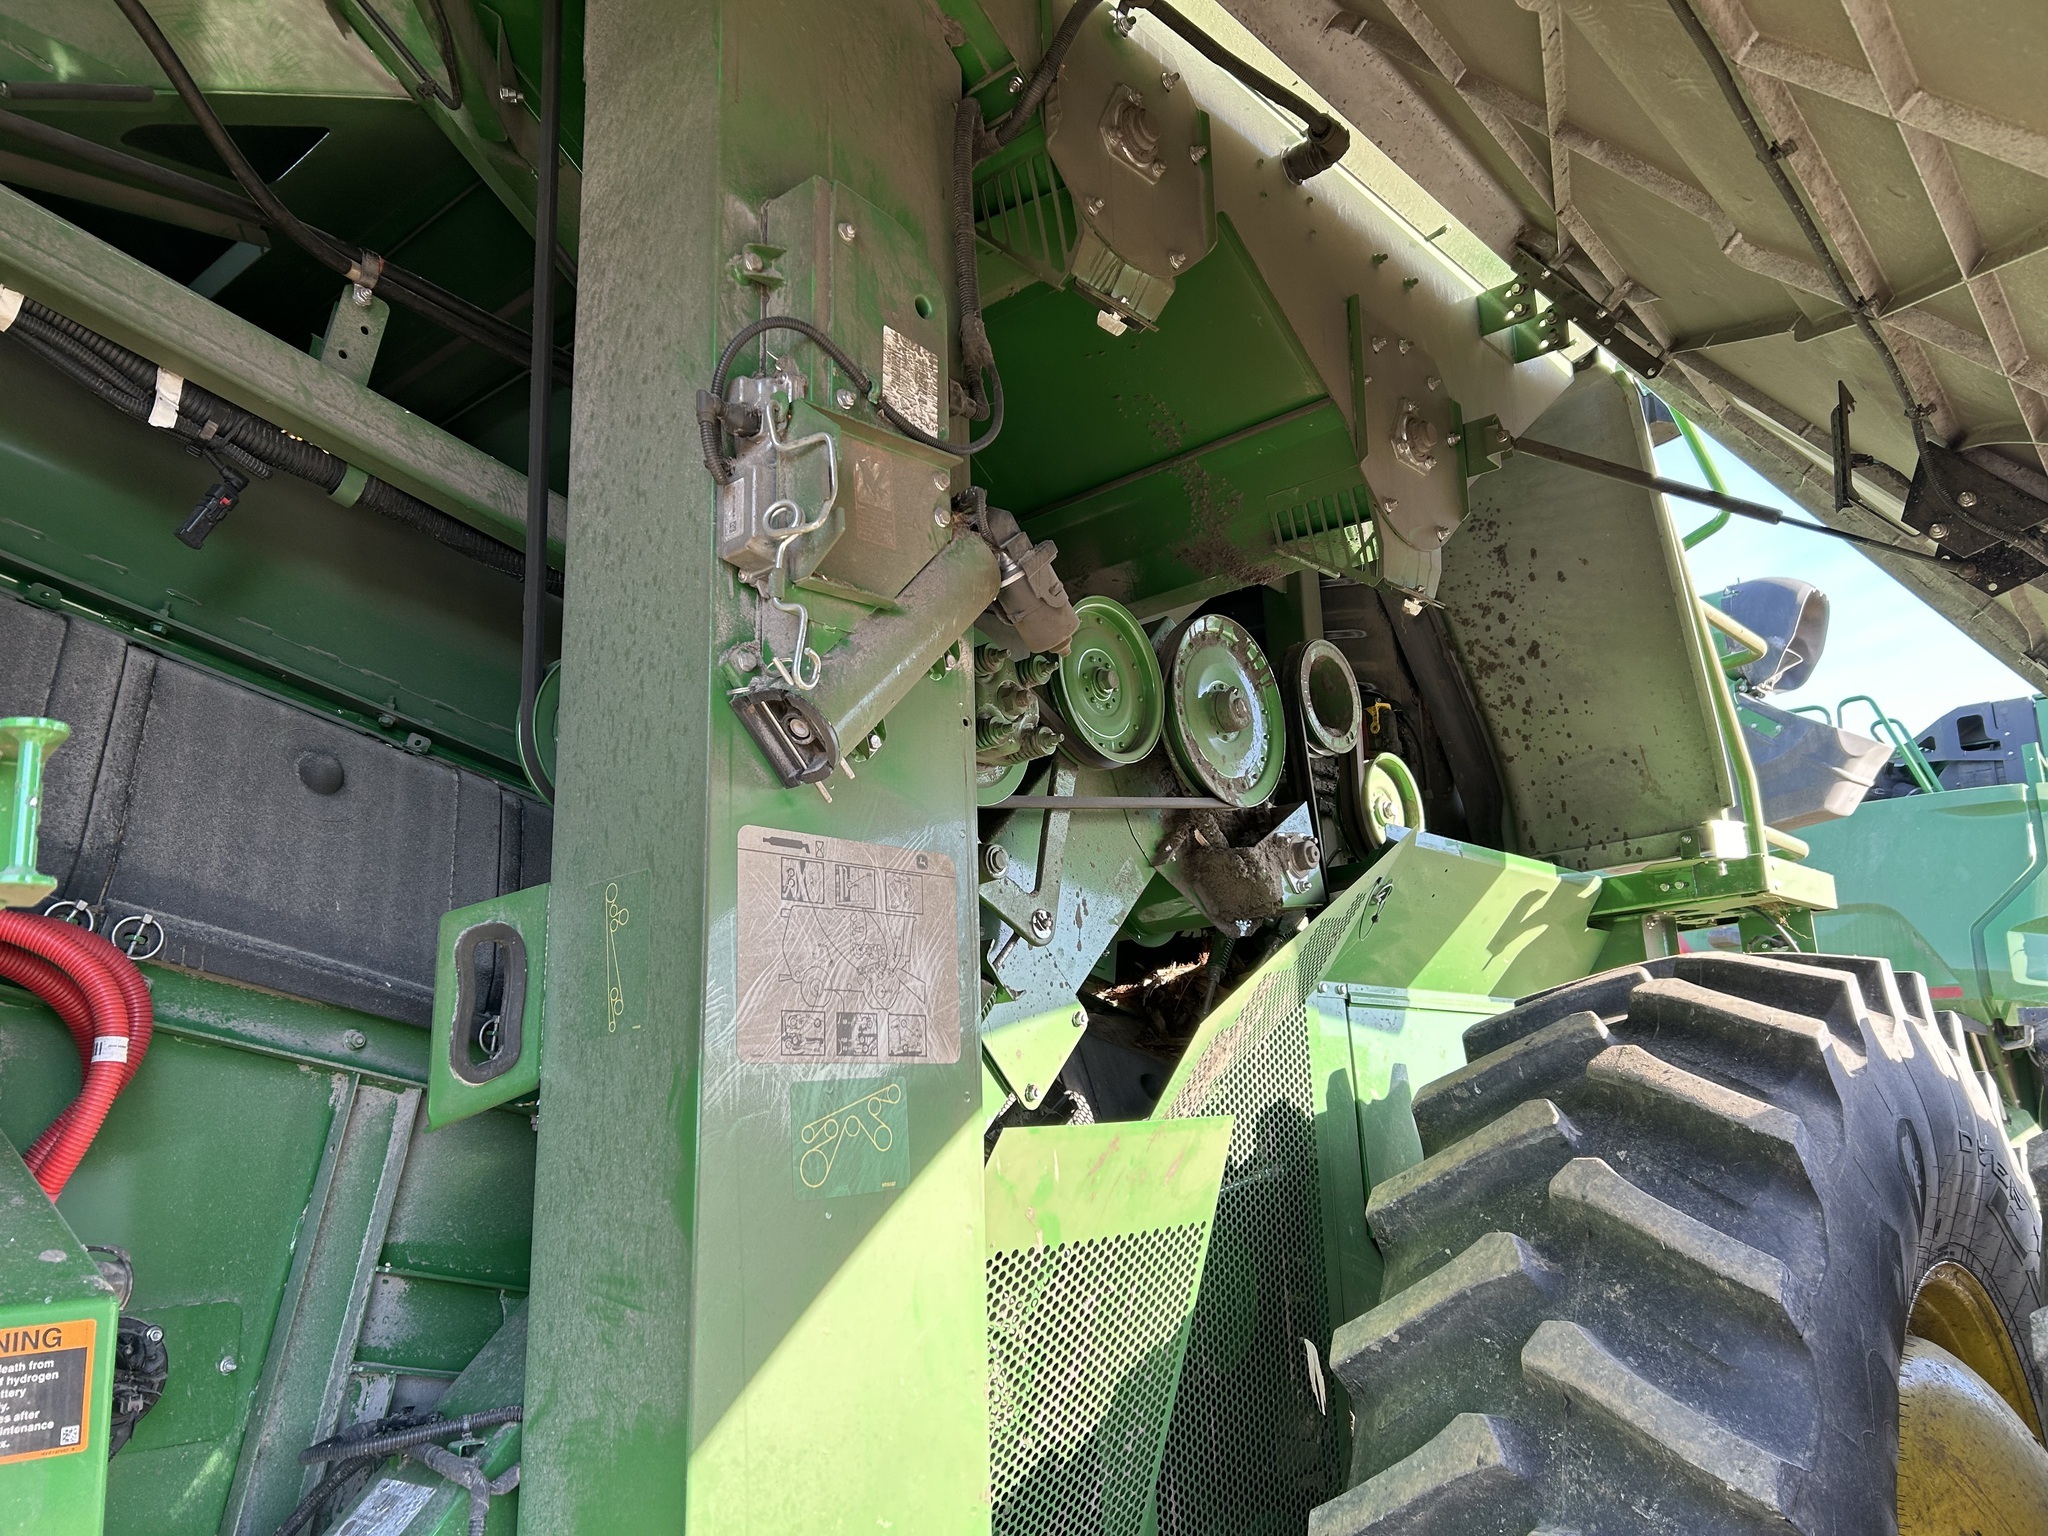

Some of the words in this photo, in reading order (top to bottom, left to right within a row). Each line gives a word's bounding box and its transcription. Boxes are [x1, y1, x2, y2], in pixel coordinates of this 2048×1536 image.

[28, 1359, 55, 1371] from
[6, 1371, 59, 1387] hydrogen
[13, 1410, 41, 1422] after
